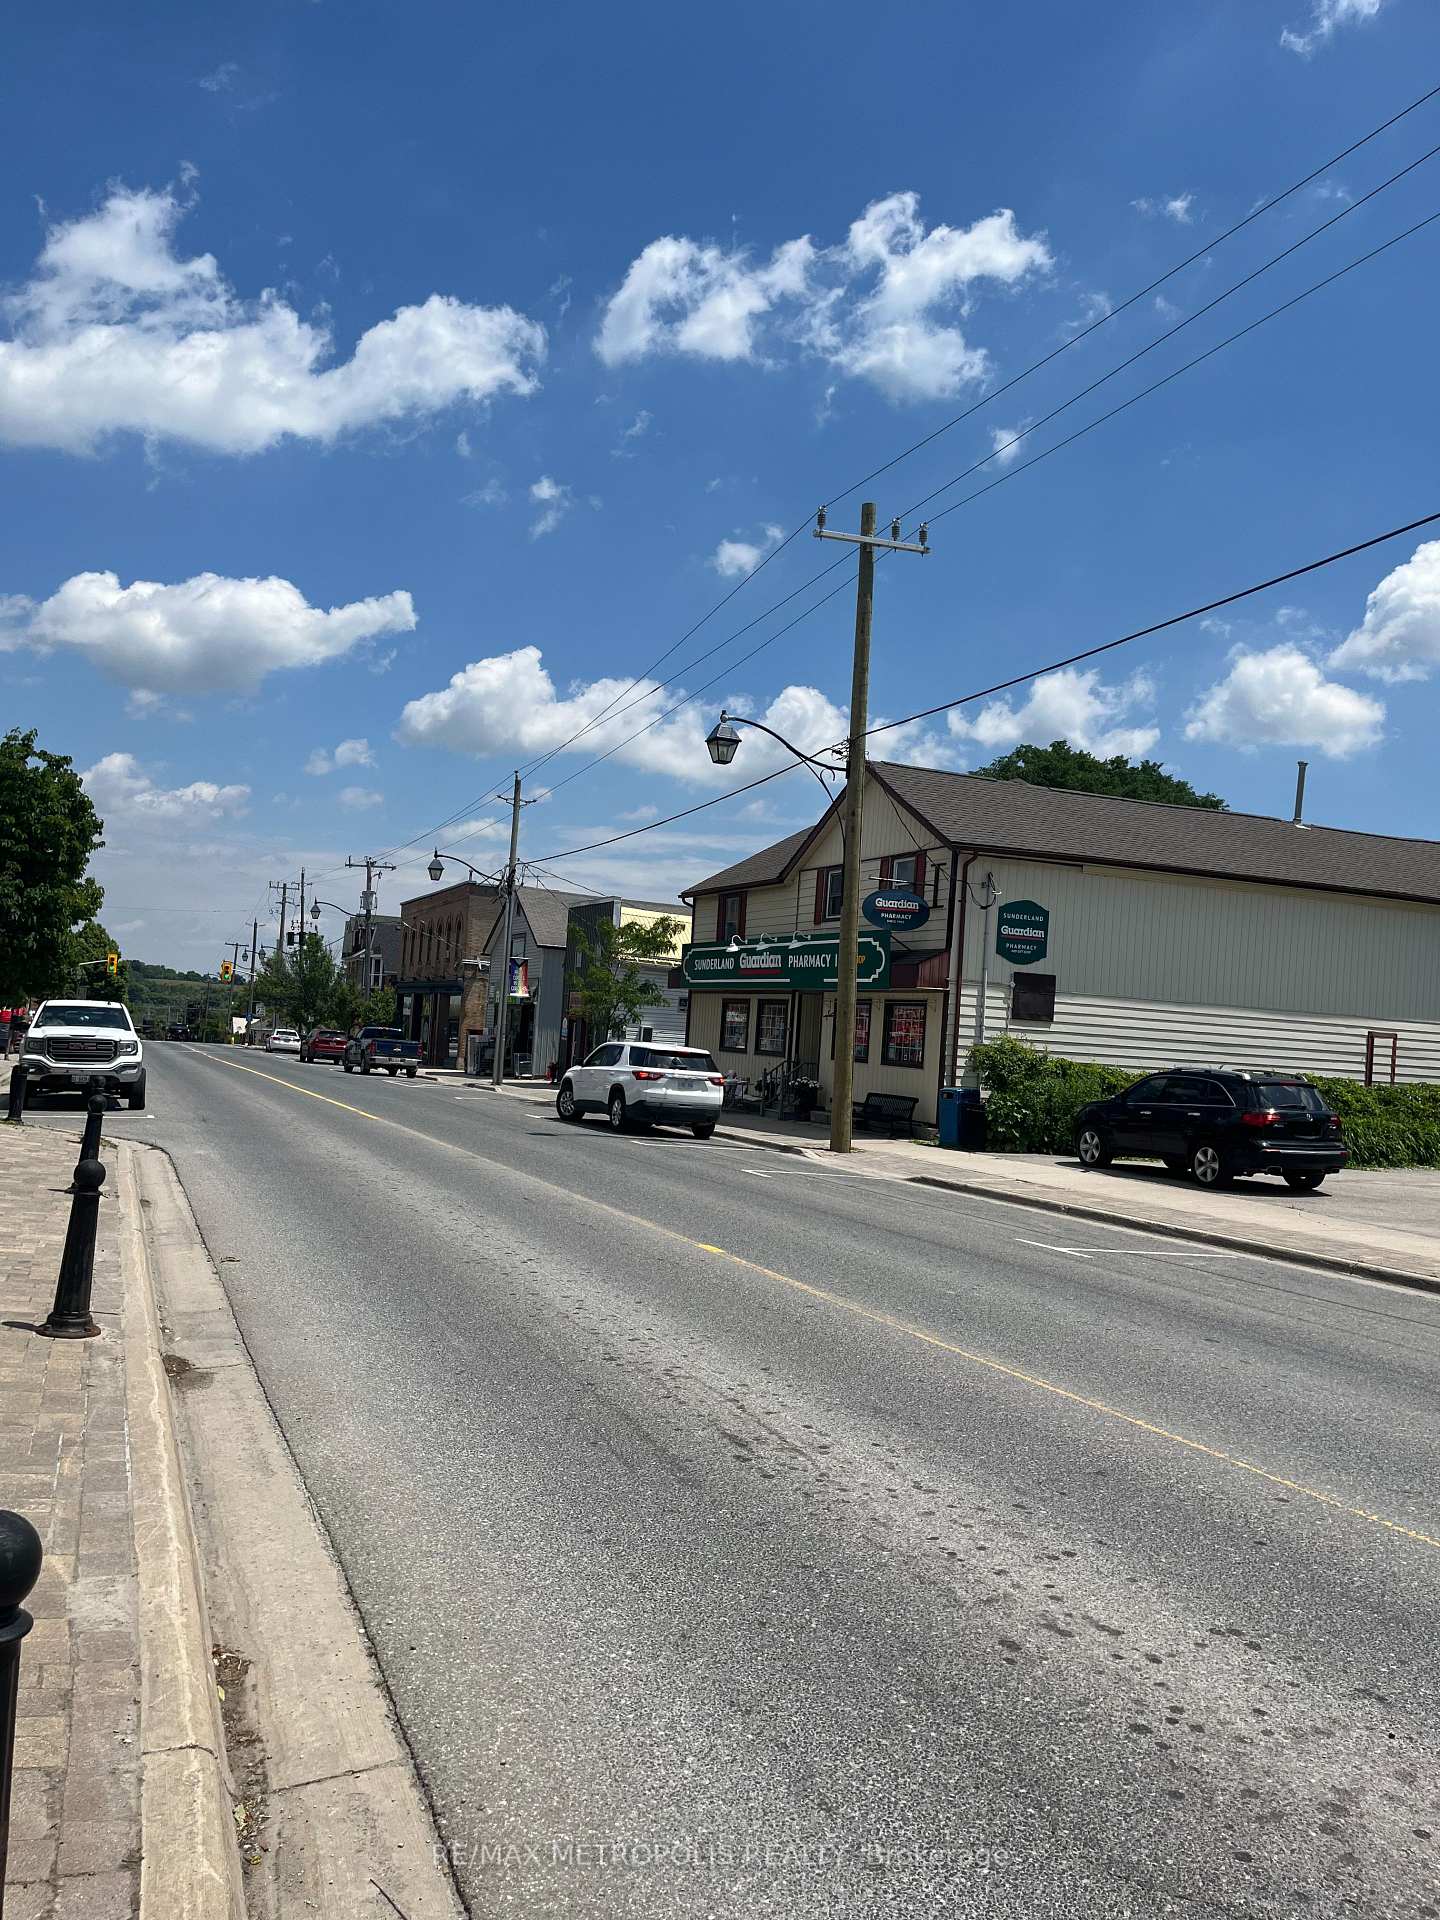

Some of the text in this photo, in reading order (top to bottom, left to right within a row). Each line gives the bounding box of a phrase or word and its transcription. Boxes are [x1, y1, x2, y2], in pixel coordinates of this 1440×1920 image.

[875, 898, 919, 910] Guardian
[880, 912, 912, 920] PHARMACY
[1003, 913, 1044, 922] SUNDERLAND
[1001, 925, 1045, 938] Guardian
[1006, 943, 1037, 951] PHARMACY
[694, 957, 735, 971] SUNDERLAND
[739, 952, 782, 969] Guardian
[788, 953, 831, 968] PHARMACY
